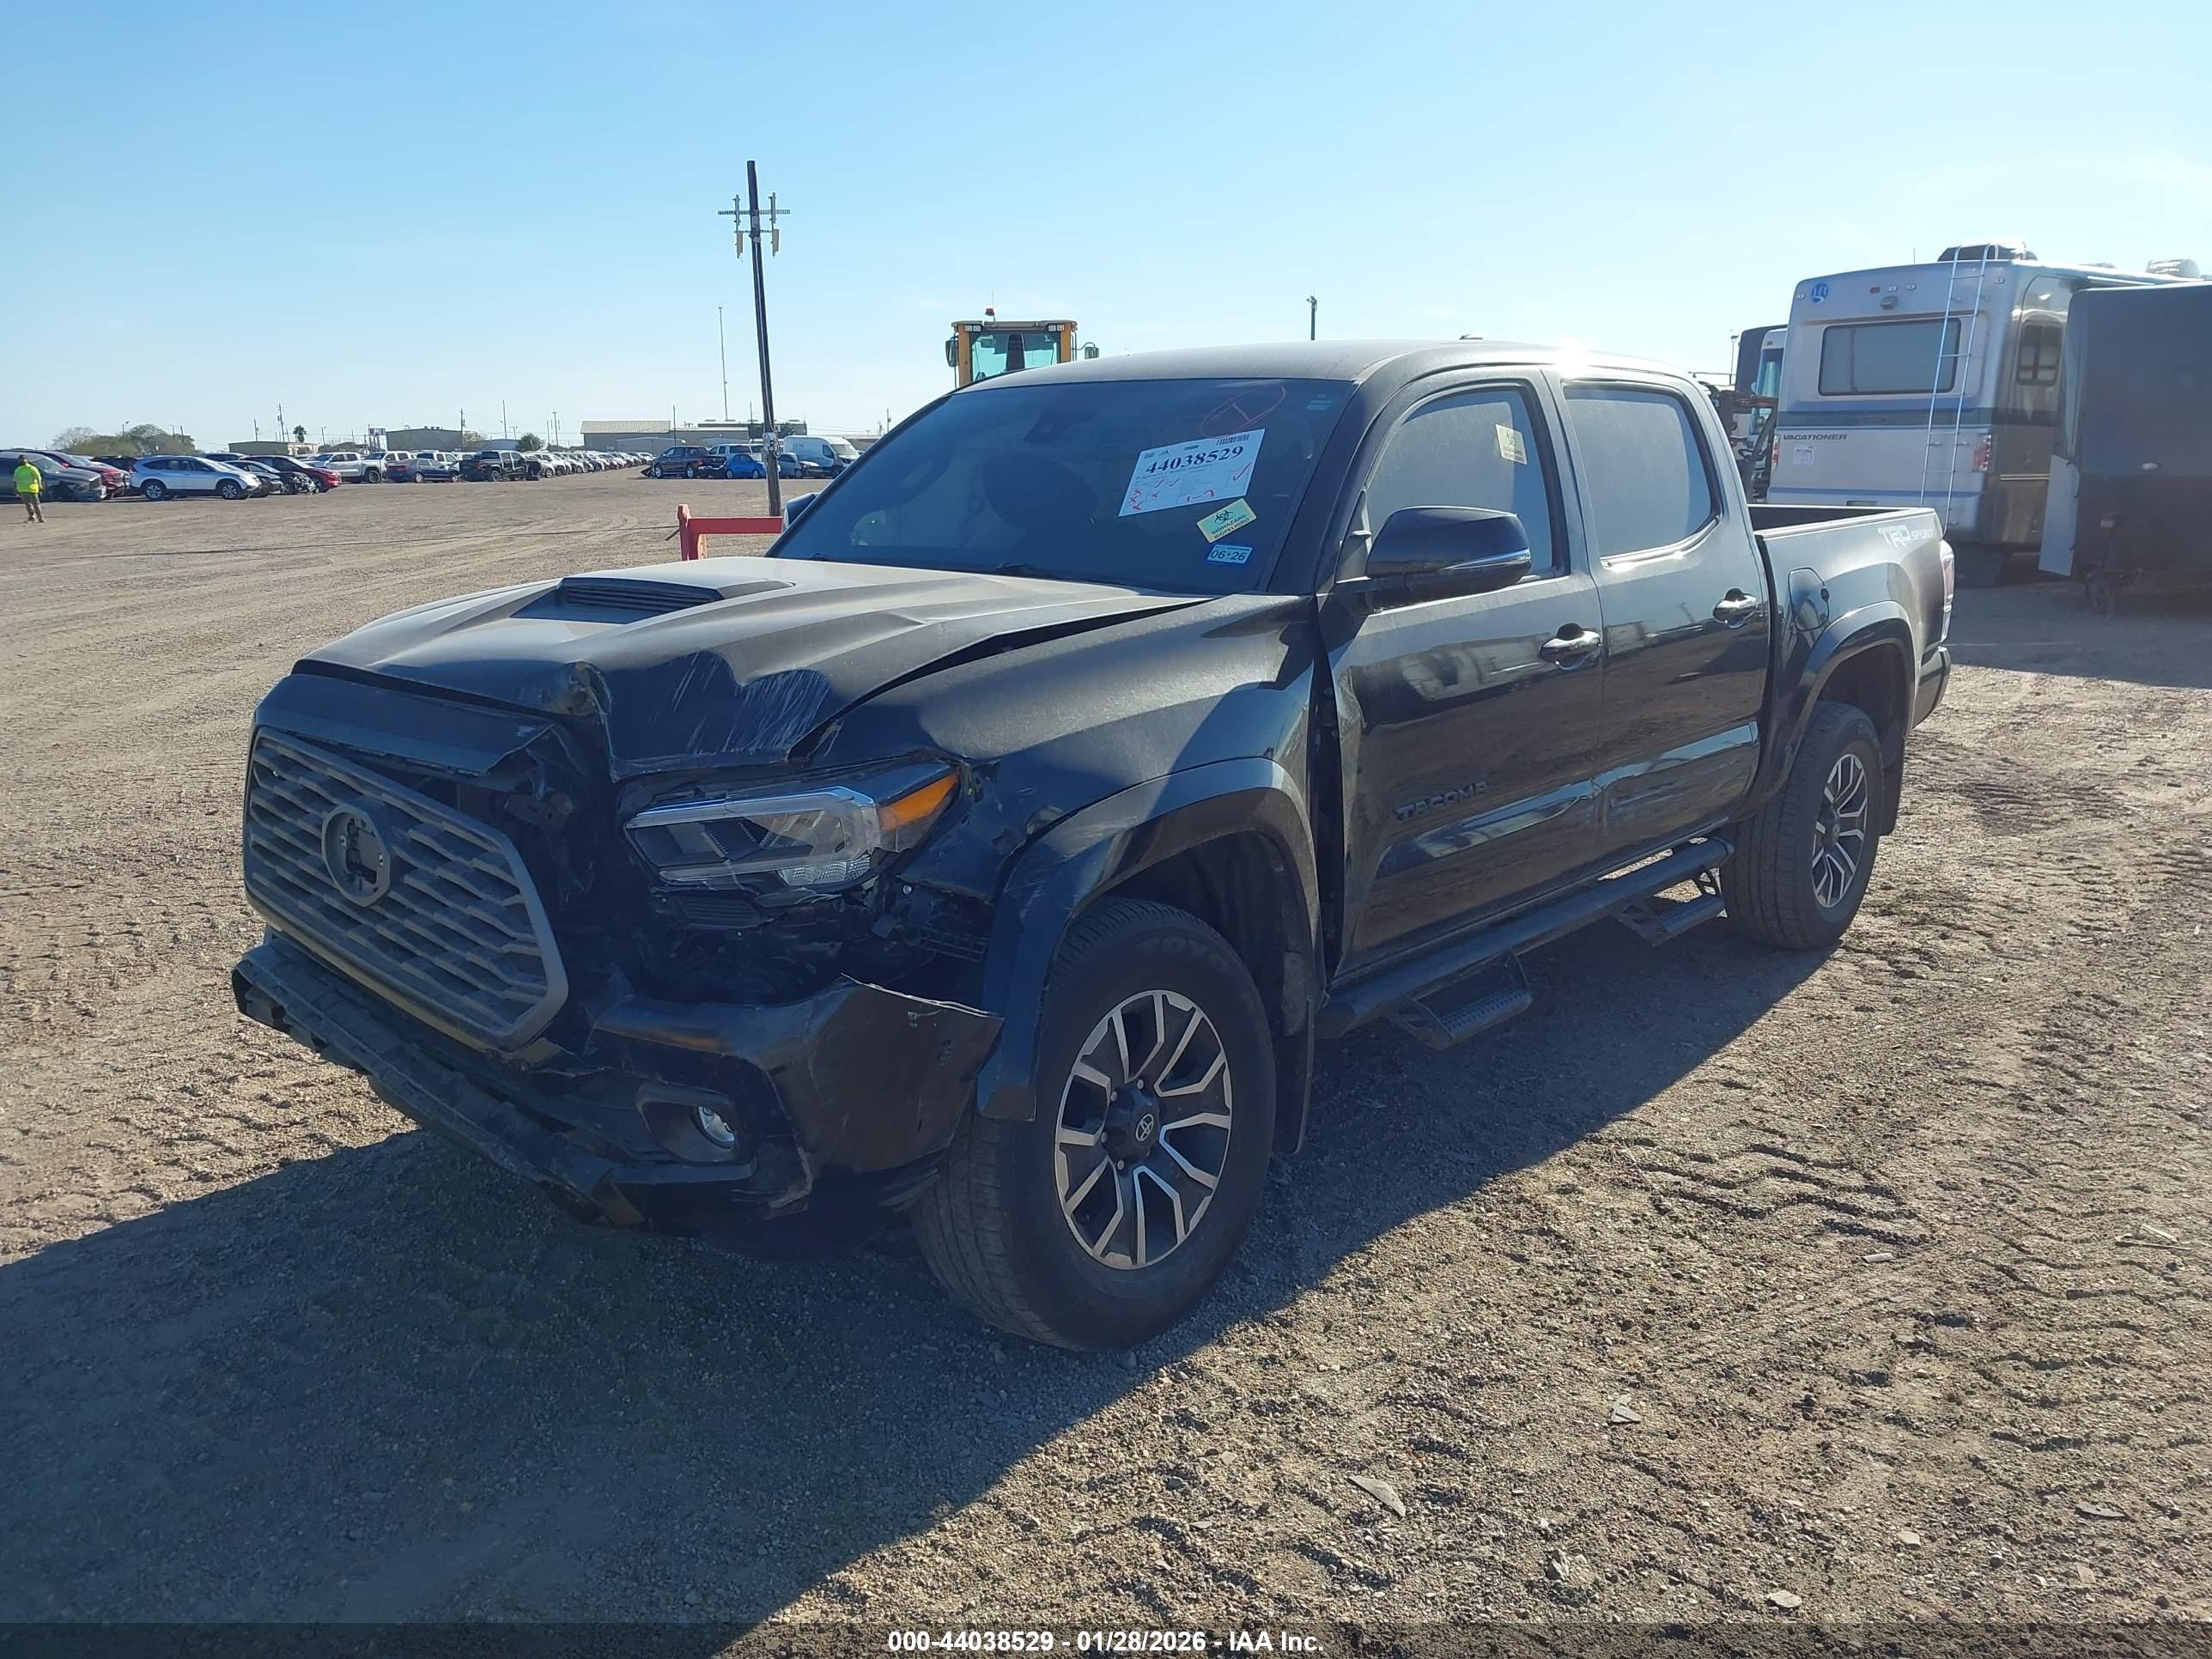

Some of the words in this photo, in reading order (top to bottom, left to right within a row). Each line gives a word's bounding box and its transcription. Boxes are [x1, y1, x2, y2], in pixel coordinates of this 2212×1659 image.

[1146, 445, 1244, 474] 44038529
[1212, 514, 1247, 535] BIOHAZARD
[1877, 524, 1911, 550] TRD
[1394, 781, 1489, 821] TACOMA
